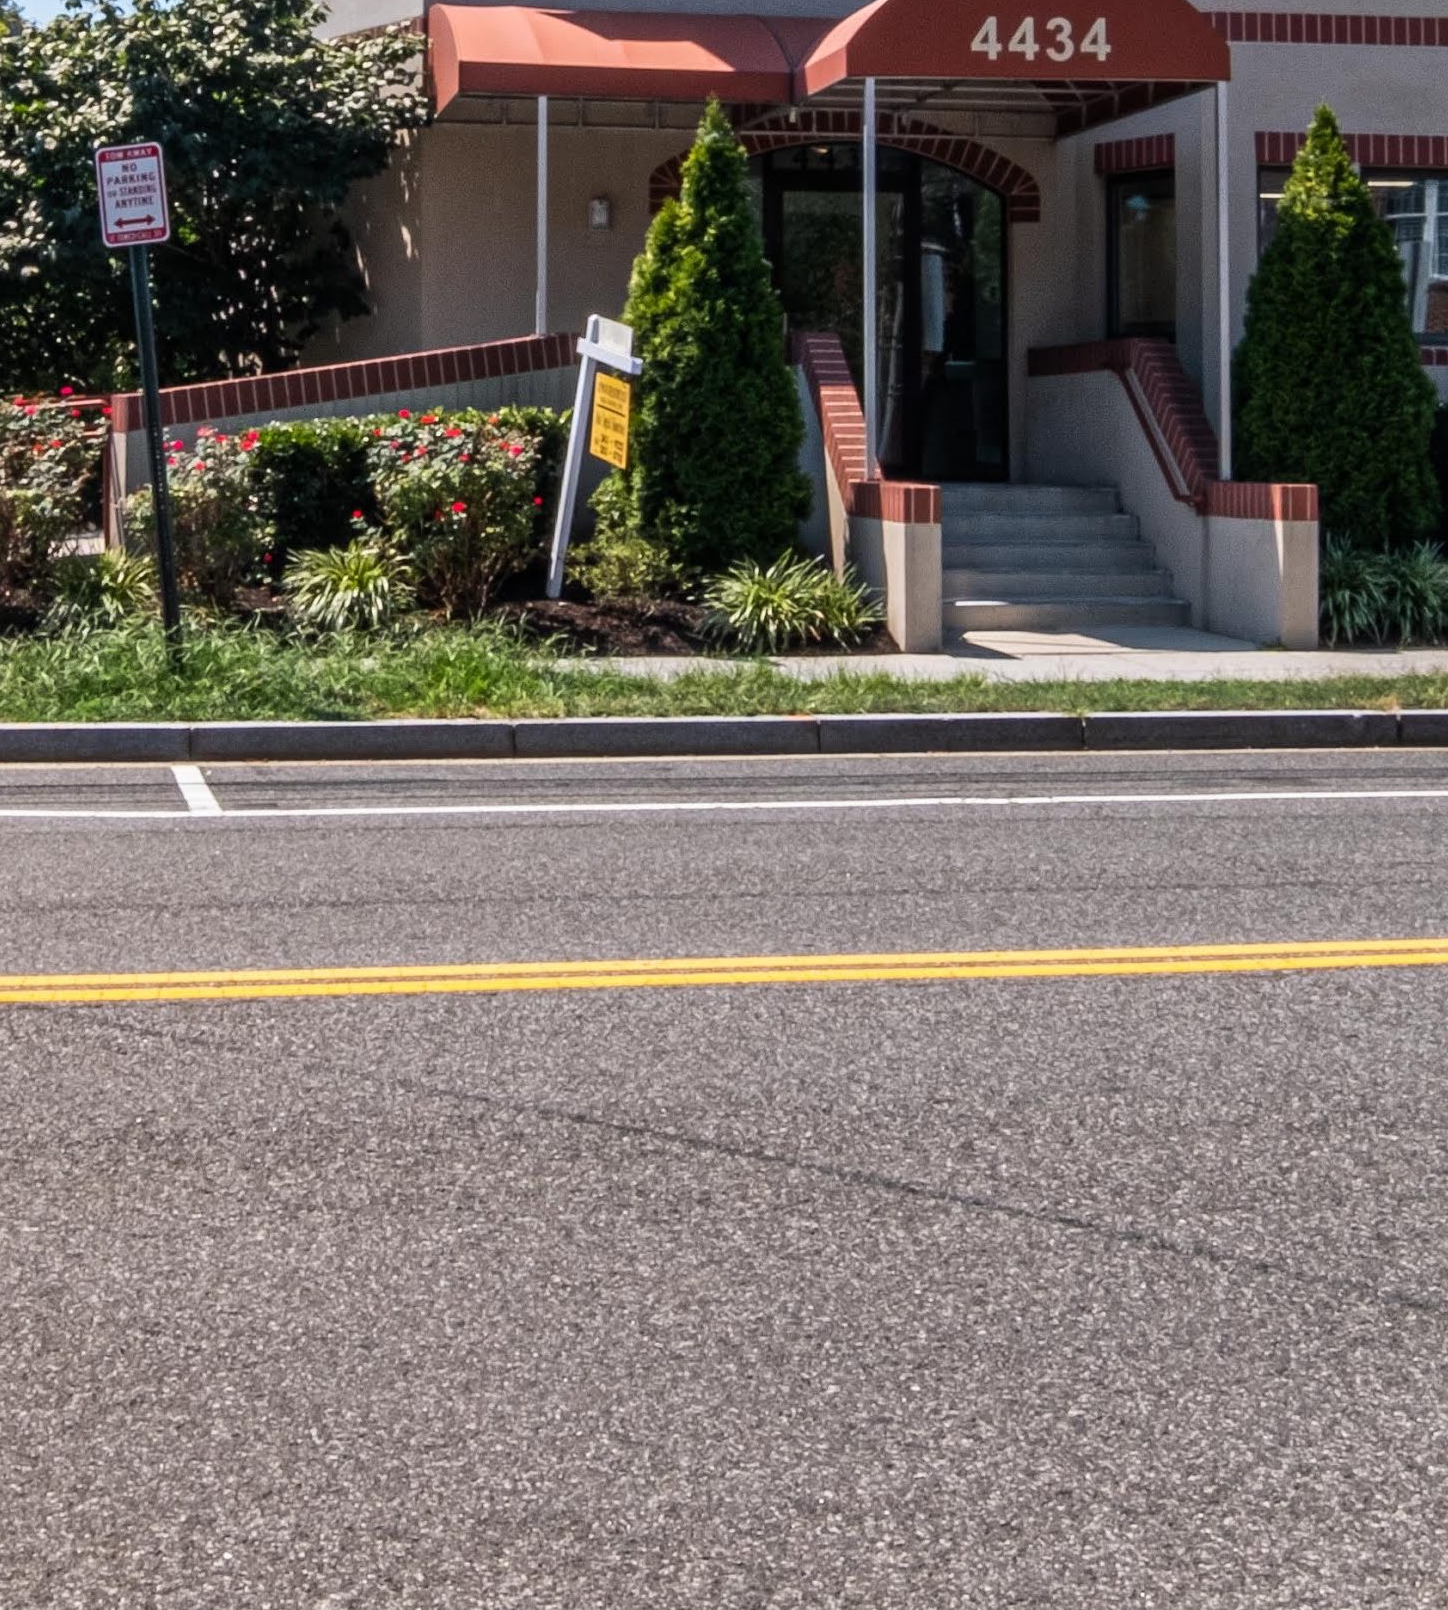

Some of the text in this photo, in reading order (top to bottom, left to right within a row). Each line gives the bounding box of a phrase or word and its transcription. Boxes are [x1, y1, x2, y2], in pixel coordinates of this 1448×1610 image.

[970, 15, 1112, 62] 4434
[122, 163, 138, 172] NO
[107, 172, 157, 186] PARKING
